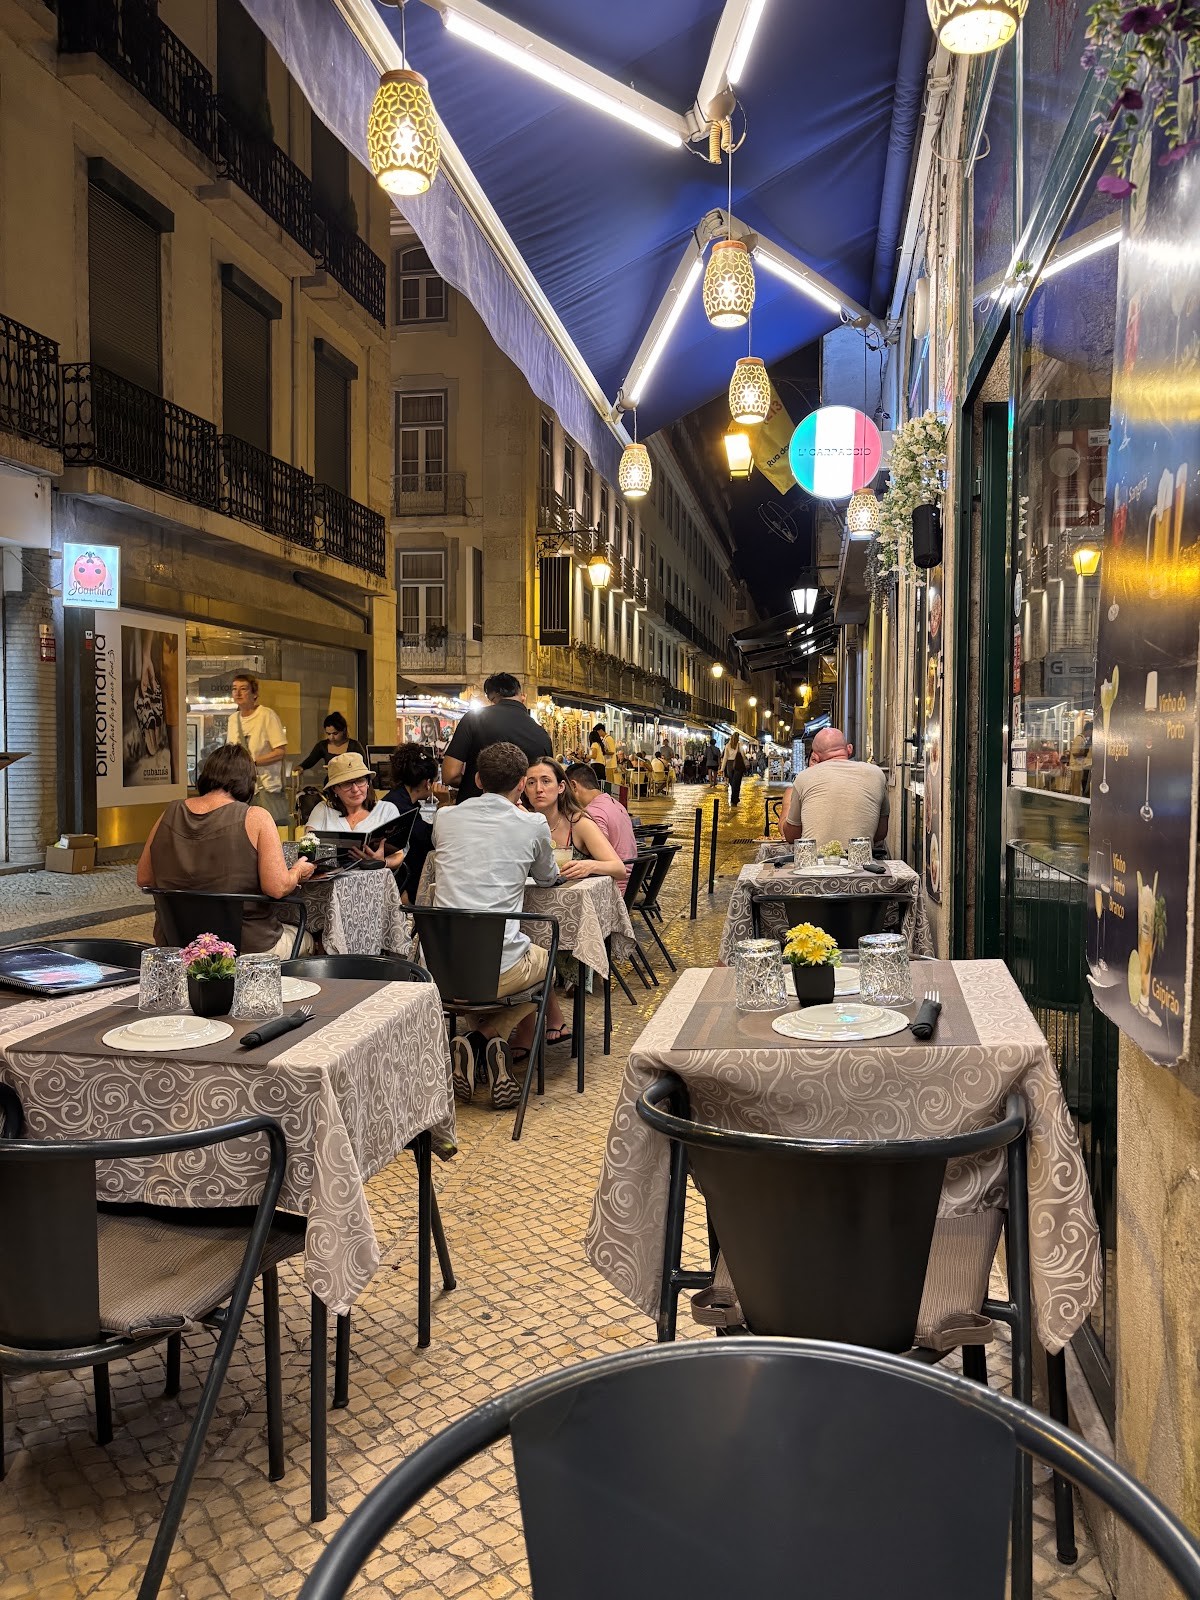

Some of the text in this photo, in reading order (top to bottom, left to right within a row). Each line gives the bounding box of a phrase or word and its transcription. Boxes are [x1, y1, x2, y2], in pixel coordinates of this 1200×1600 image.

[766, 443, 790, 467] Rua do
[68, 580, 113, 597] Joaninha
[95, 633, 107, 777] birkomania
[1159, 692, 1177, 712] Vinho
[1166, 720, 1185, 739] Porto
[1113, 852, 1126, 874] Vinho
[1113, 875, 1126, 897] Tinto
[1109, 896, 1125, 920] Branco
[1152, 976, 1180, 1016] Caipirão
